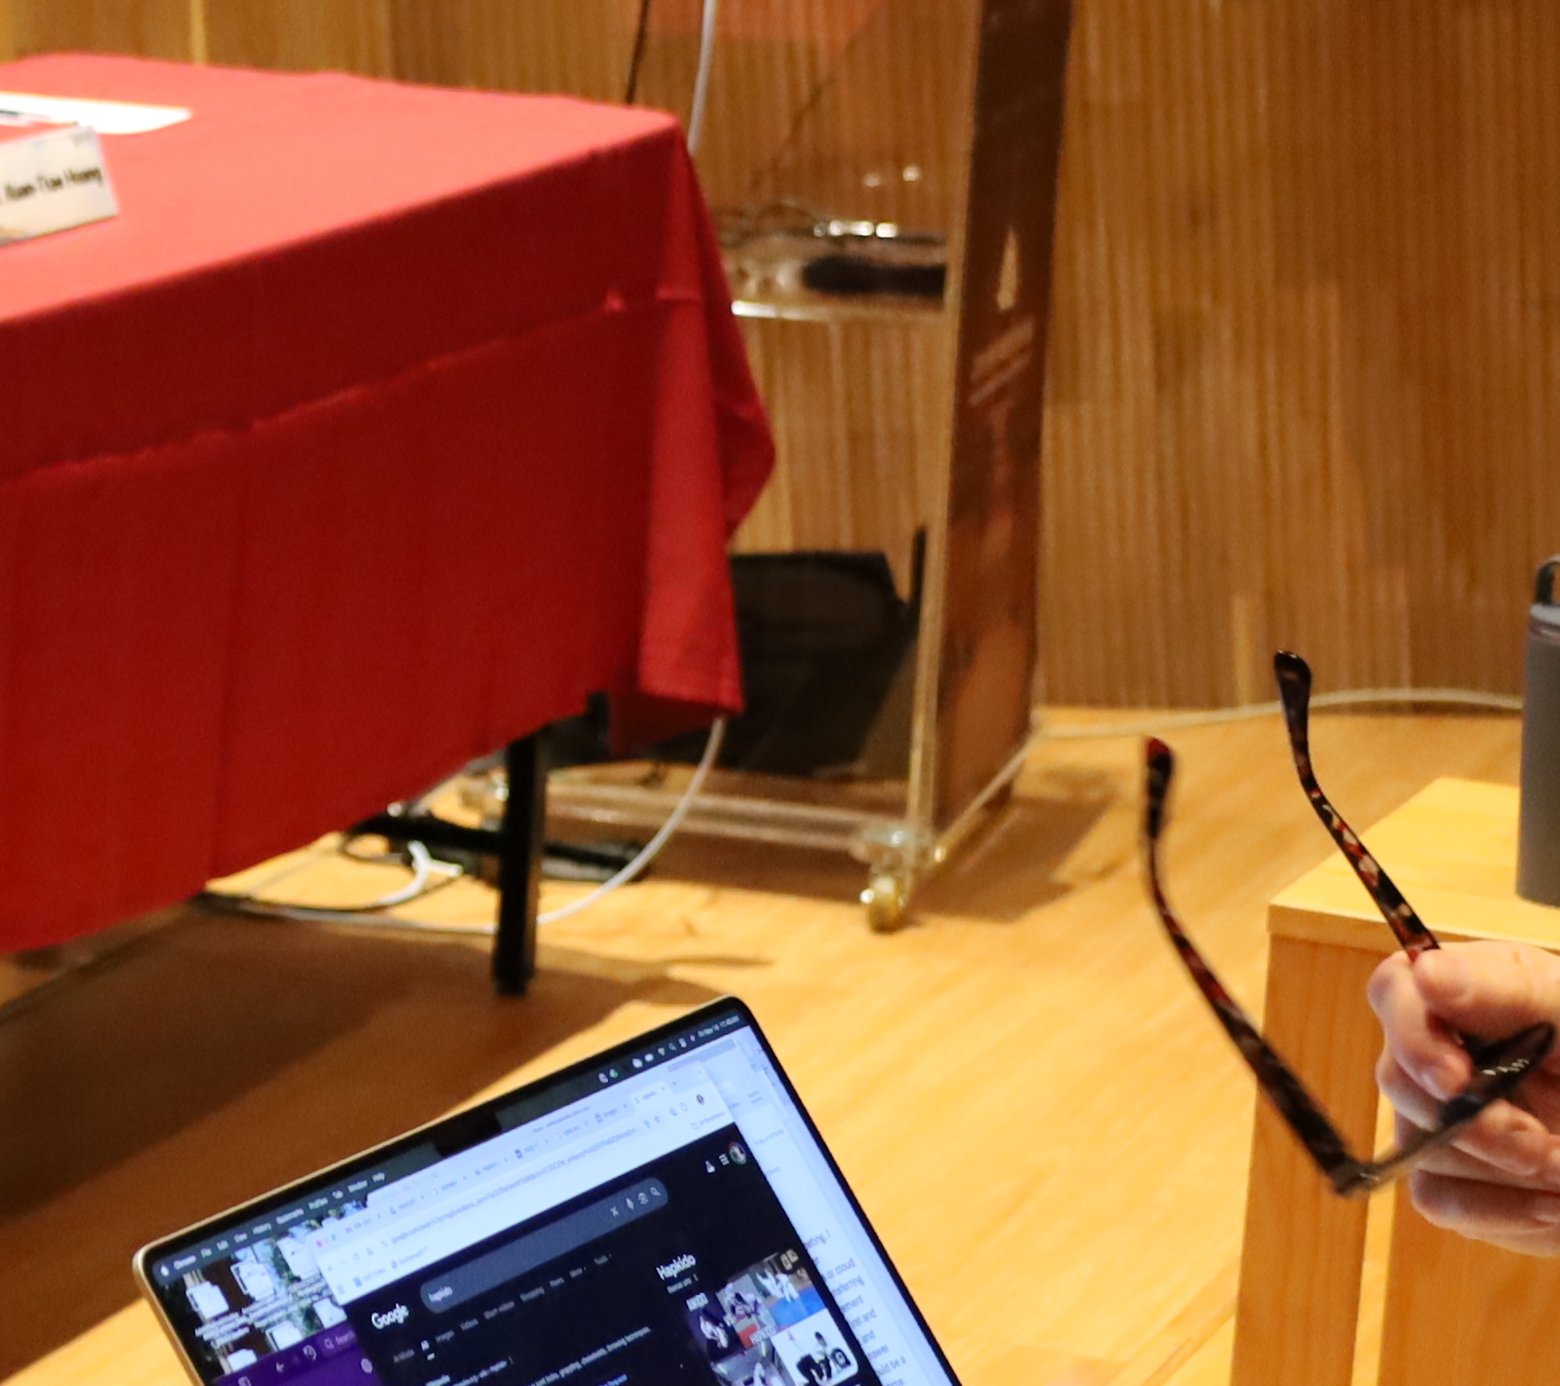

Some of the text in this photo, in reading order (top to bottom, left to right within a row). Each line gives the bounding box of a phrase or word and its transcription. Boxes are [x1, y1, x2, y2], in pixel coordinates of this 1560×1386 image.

[172, 1254, 196, 1270] Chrome
[215, 1239, 229, 1251] Edit
[251, 1222, 272, 1234] History
[371, 1171, 385, 1182] Help
[656, 1253, 696, 1279] Hapkido
[833, 1257, 856, 1275] cloud
[427, 1285, 453, 1302] hapkido
[684, 1292, 708, 1311] AIKIDO
[370, 1303, 409, 1329] Google
[861, 1307, 877, 1323] and
[420, 1339, 430, 1351] All
